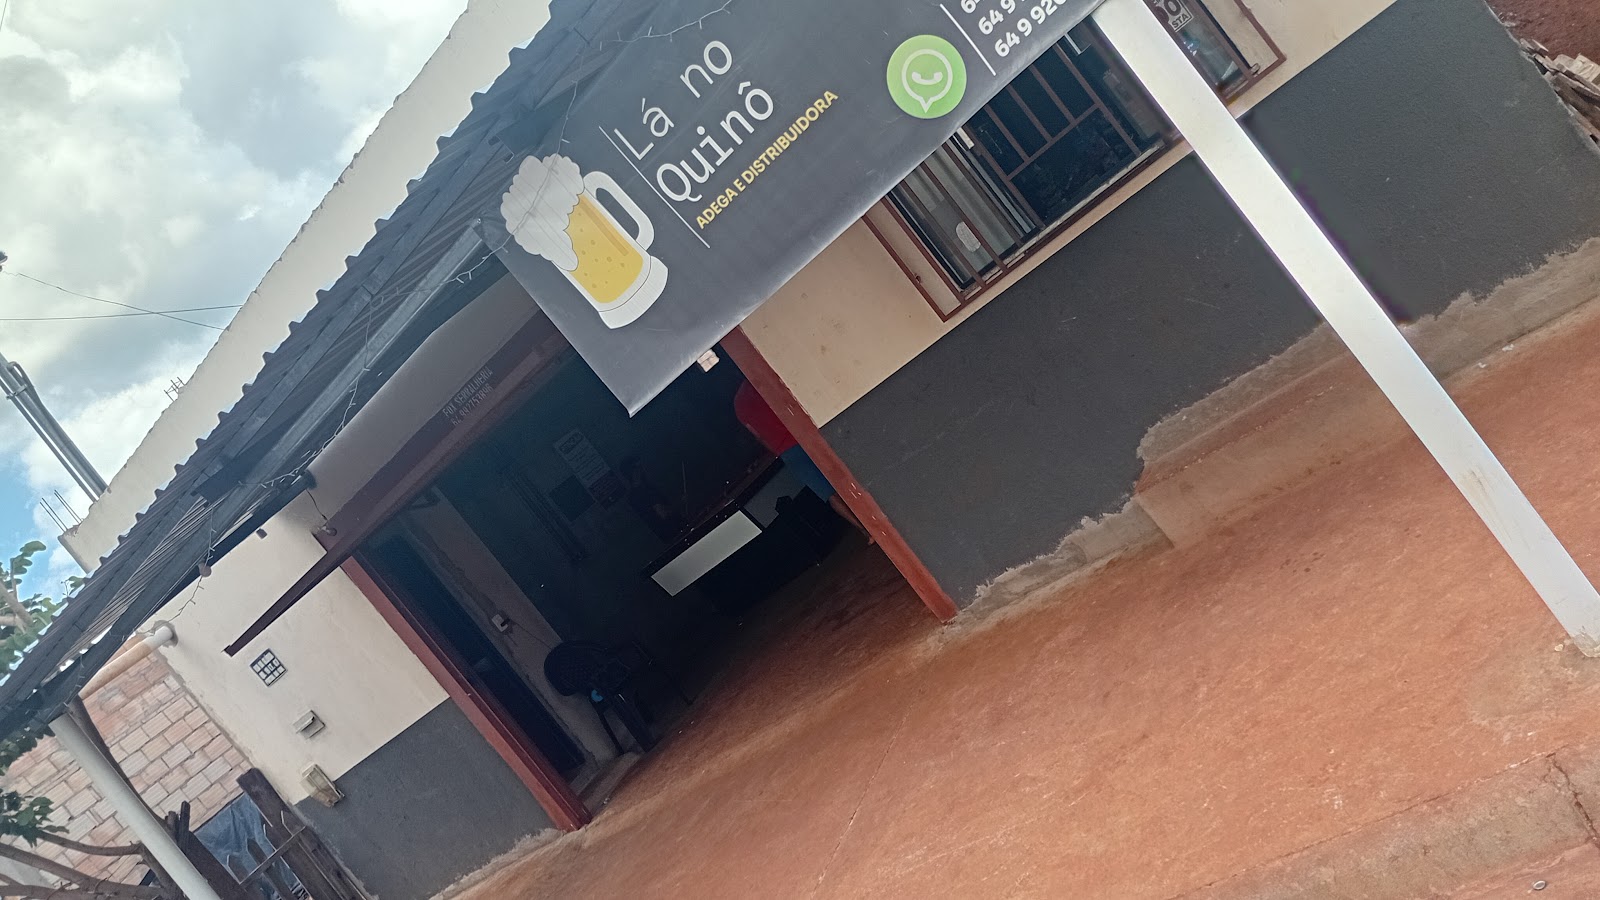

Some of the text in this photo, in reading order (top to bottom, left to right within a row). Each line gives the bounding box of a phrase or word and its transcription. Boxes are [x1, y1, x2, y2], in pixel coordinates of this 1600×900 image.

[978, 9, 1004, 34] 64
[994, 32, 1020, 57] 64
[1017, 18, 1032, 36] 9
[614, 40, 732, 161] Lá no
[656, 81, 774, 202] Quinô
[696, 90, 838, 229] ADEGA E DISTRIBUIDORA
